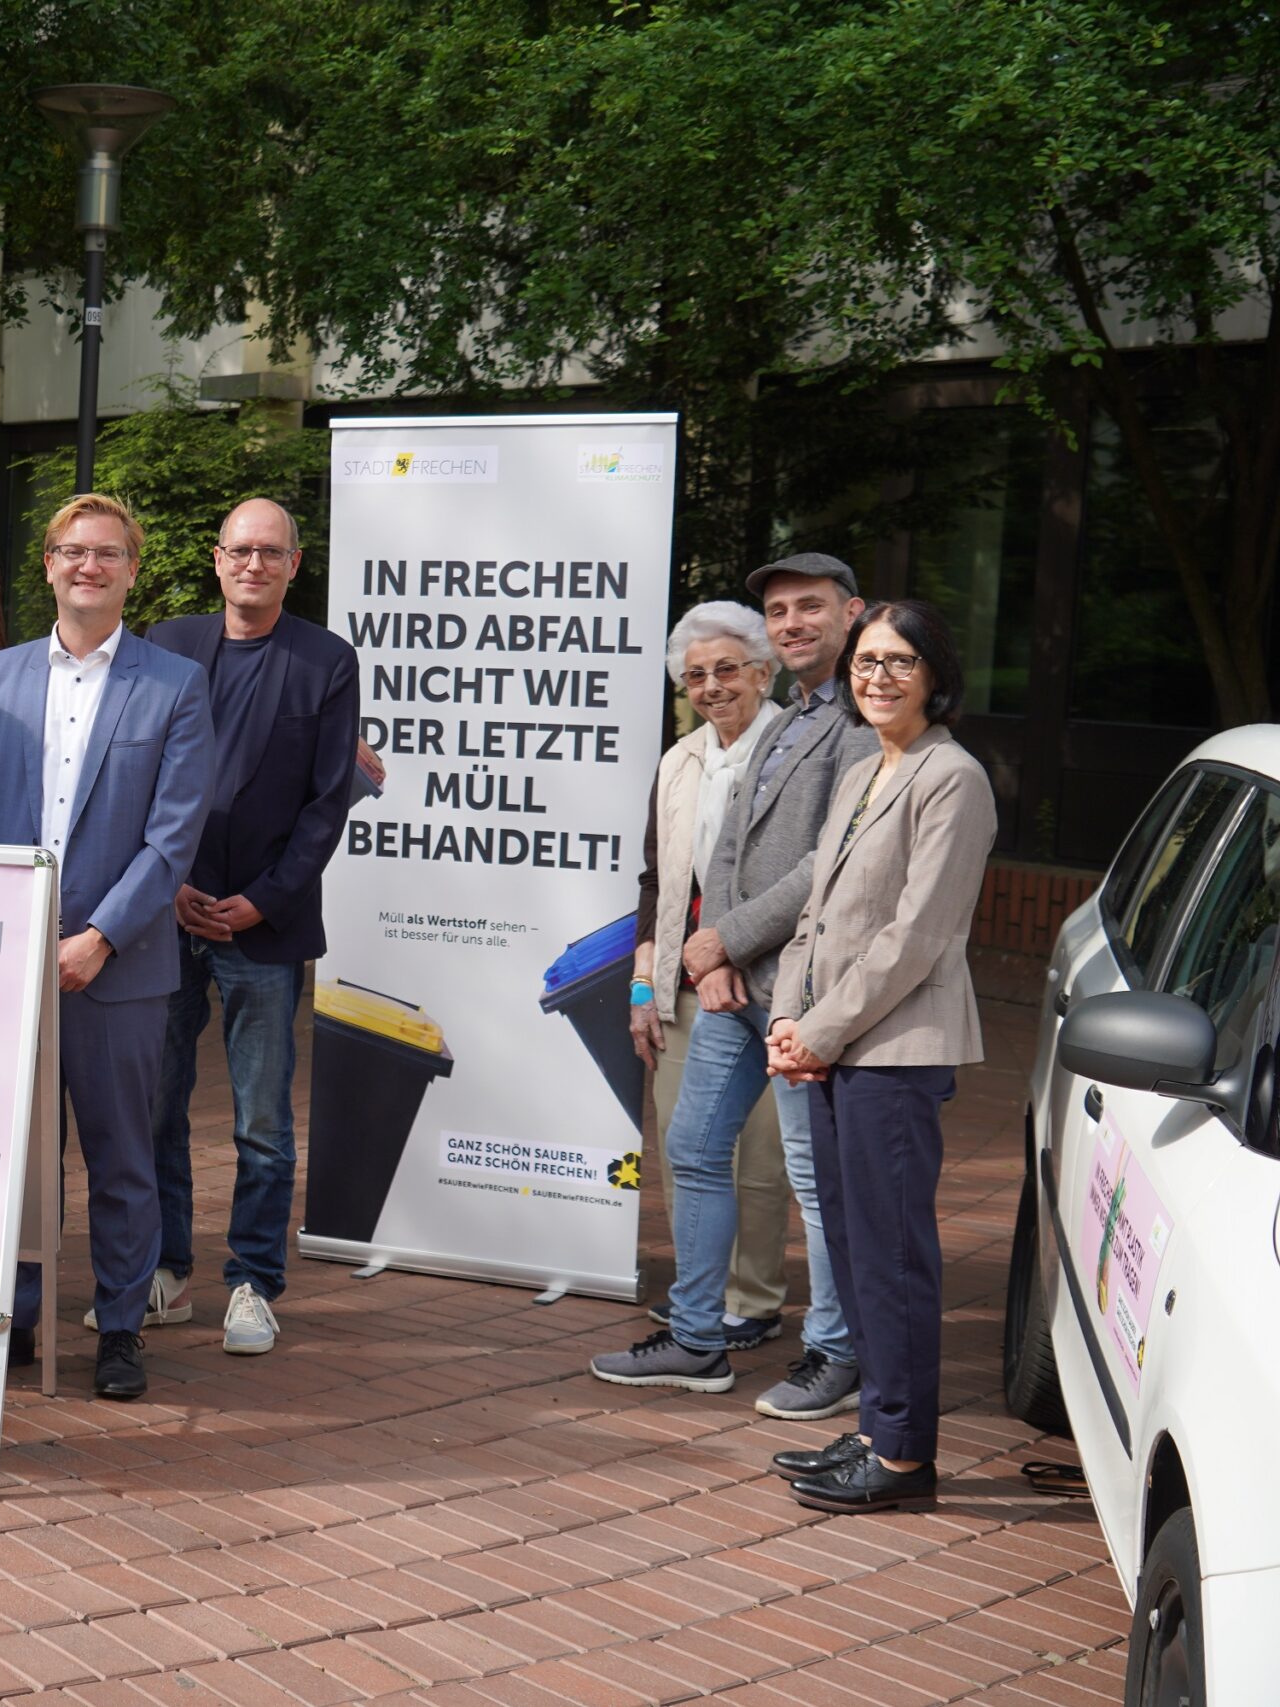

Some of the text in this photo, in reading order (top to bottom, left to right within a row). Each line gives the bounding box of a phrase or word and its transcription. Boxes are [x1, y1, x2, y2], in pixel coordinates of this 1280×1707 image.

[344, 460, 487, 476] STADT FRECHEN
[363, 560, 629, 600] IN FRECHEN
[348, 612, 643, 654] WIRD ABFALL
[373, 665, 610, 708] NICHT WIE
[360, 716, 620, 763] DER LETZTE
[424, 764, 547, 814] MÜLL
[348, 820, 622, 872] BEHANDELT!
[378, 911, 404, 924] Müll
[407, 914, 424, 925] als
[427, 914, 488, 930] Wertstoff
[490, 920, 526, 933] sehen
[384, 926, 511, 948] ist besser für uns alle.
[447, 1152, 598, 1180] GANZ SCHÖN FRECHEN!
[448, 1138, 588, 1166] GANZ SCHÖN SAUBER,
[438, 1178, 623, 1208] #SAUBERwieFRECHEN SAUBERwieFRECHEN.de
